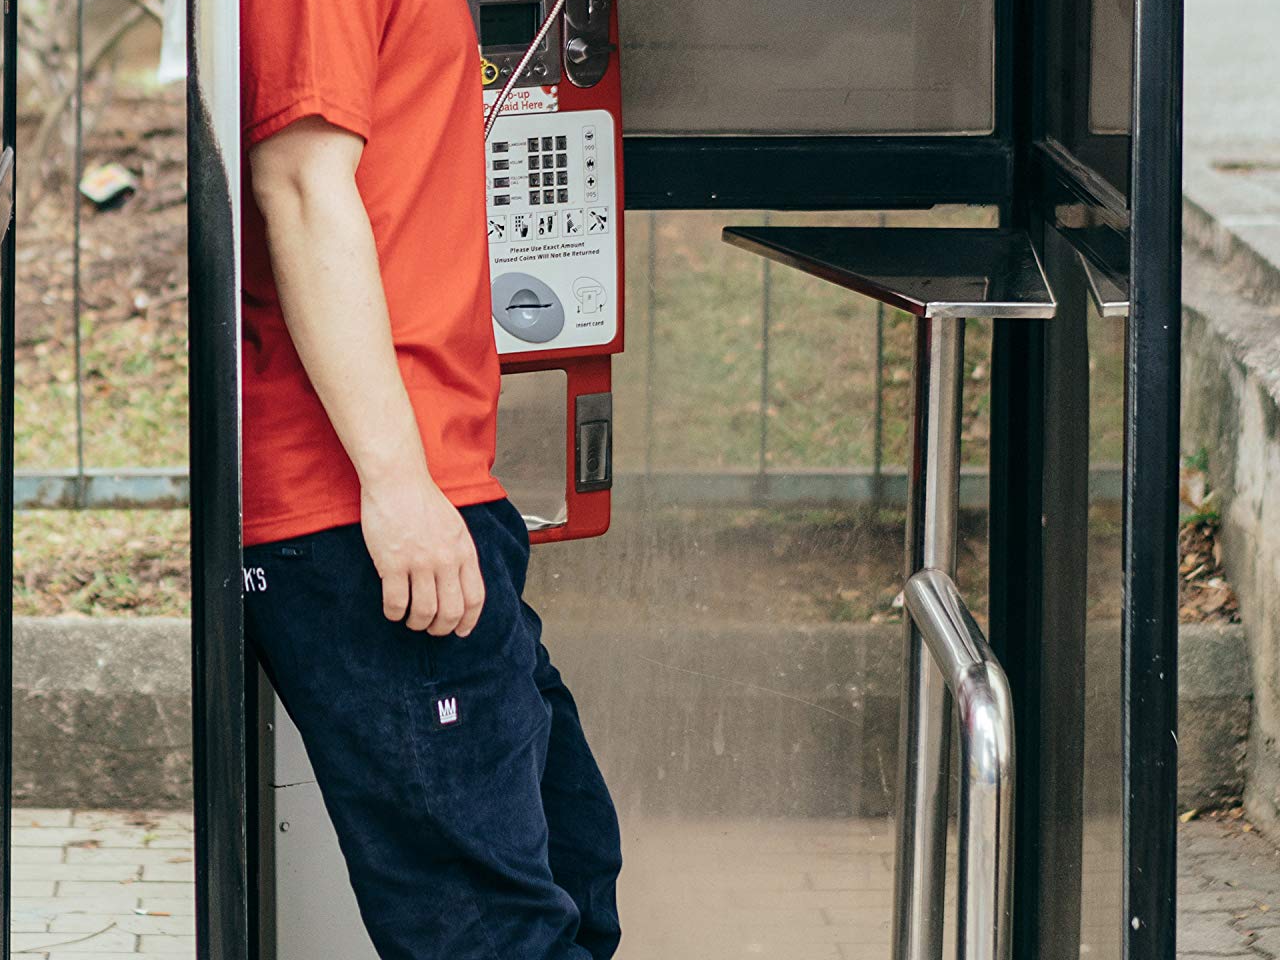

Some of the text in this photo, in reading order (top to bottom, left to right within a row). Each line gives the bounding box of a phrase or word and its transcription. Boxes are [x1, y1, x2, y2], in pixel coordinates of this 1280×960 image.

[495, 90, 530, 101] Tp-up
[484, 100, 543, 113] Praid Here
[510, 246, 530, 254] Please
[543, 243, 560, 251] Exact
[494, 256, 518, 264] Unused
[519, 254, 536, 262] Coins
[571, 248, 600, 256] Returned
[575, 320, 604, 329] insert card
